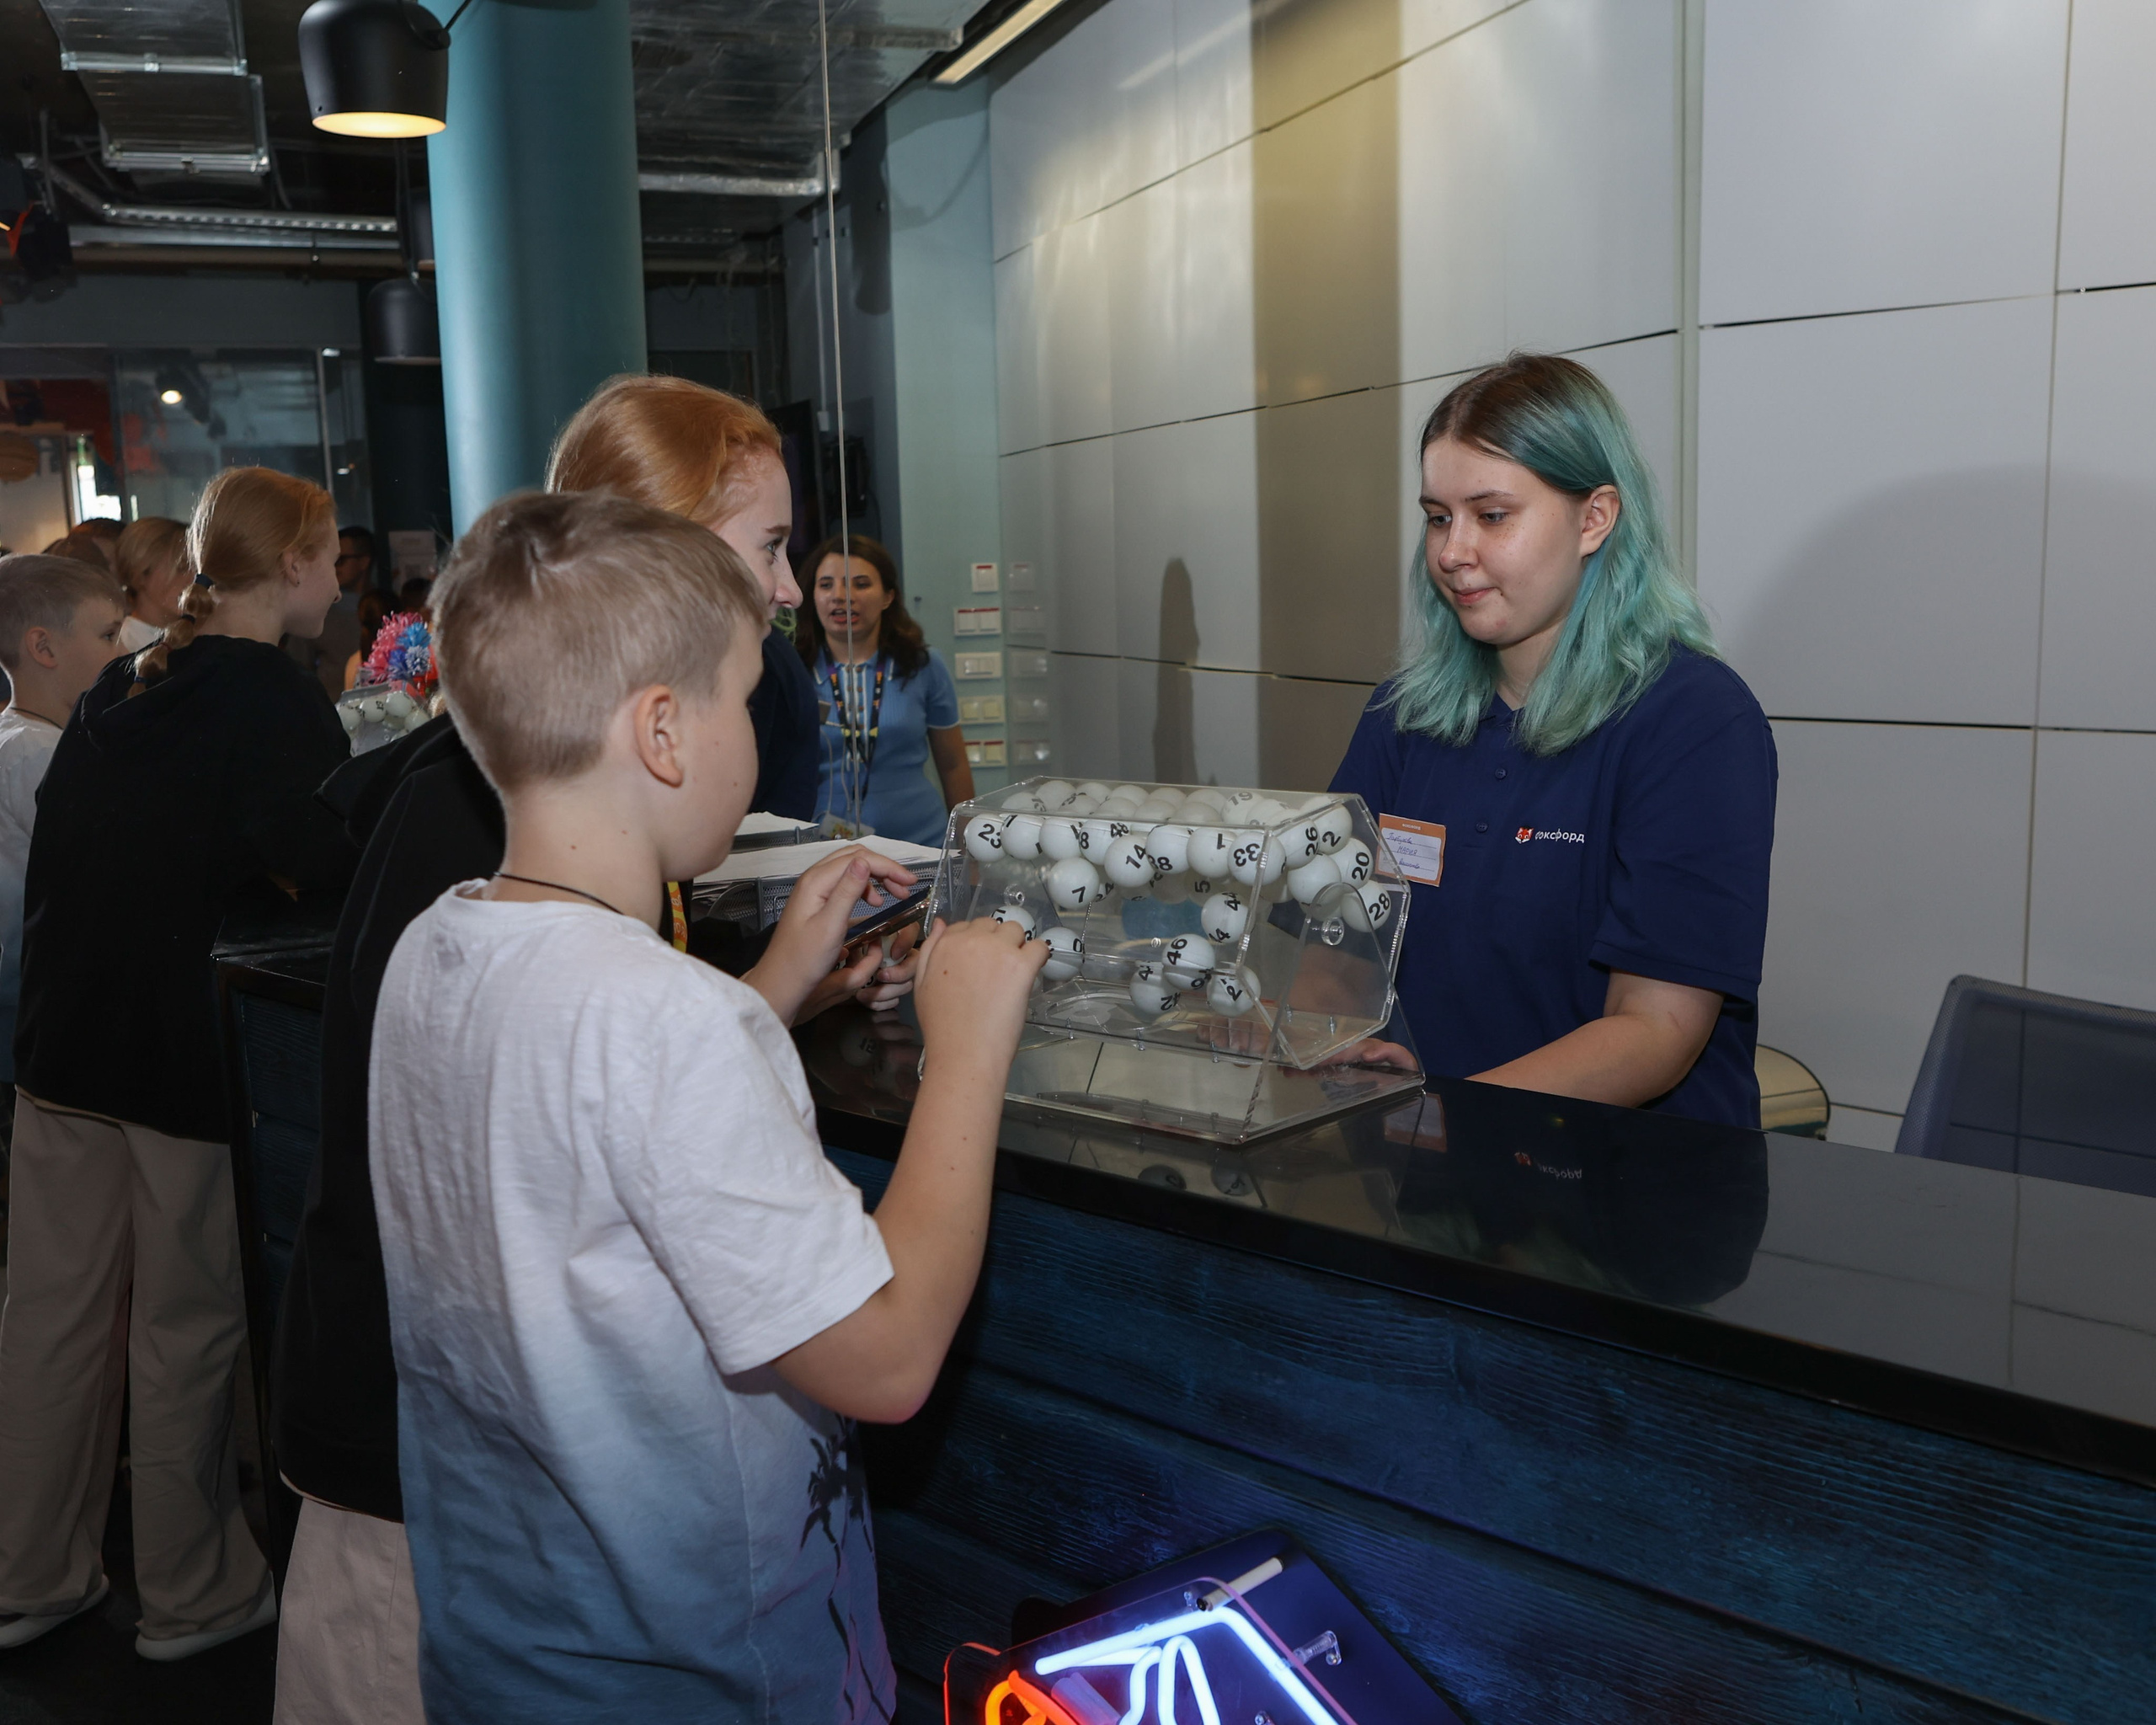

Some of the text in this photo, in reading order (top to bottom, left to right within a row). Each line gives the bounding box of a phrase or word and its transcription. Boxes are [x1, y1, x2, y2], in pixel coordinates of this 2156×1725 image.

[978, 823, 1002, 849] 23
[1305, 826, 1319, 857] 26
[1125, 844, 1146, 869] 14
[1351, 852, 1370, 881] 20
[1071, 885, 1086, 904] 7
[1369, 893, 1390, 921] 28
[1166, 937, 1188, 966] 46
